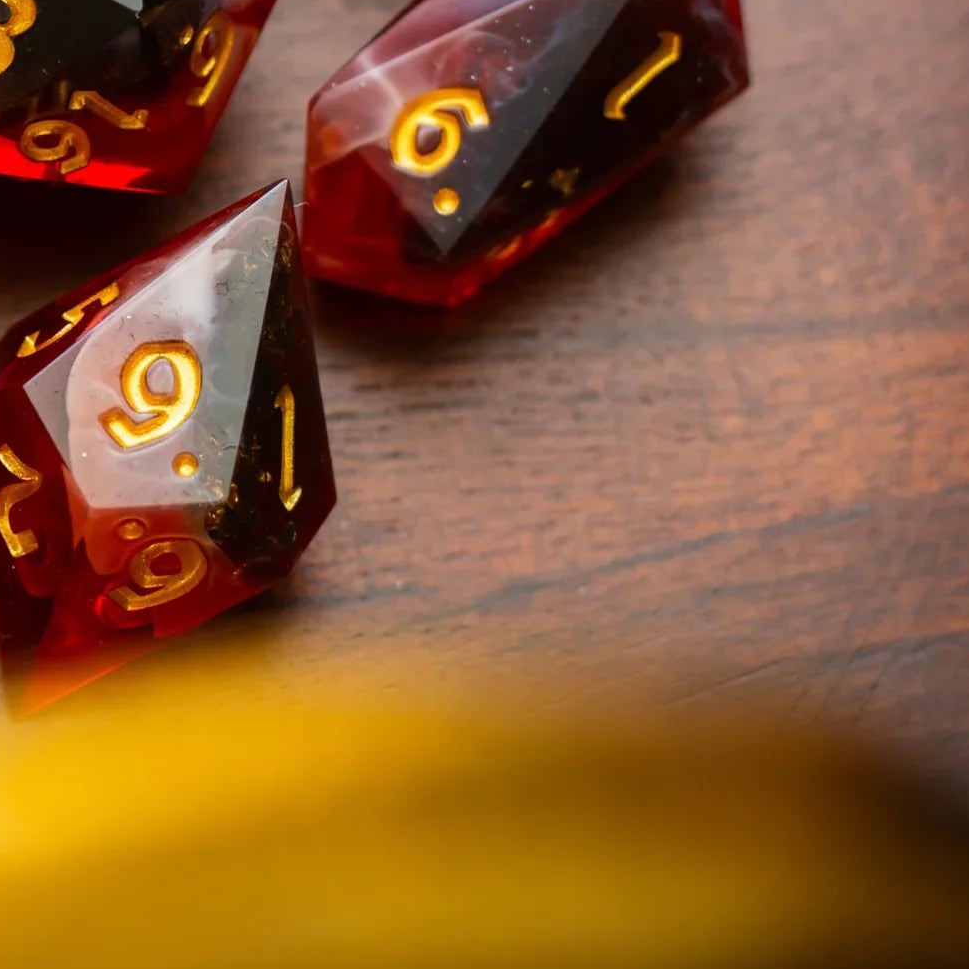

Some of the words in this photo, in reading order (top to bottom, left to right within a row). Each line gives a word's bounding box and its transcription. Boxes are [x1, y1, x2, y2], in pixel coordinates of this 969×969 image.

[603, 32, 683, 120] 1
[16, 281, 121, 358] 5
[274, 384, 302, 511] 1
